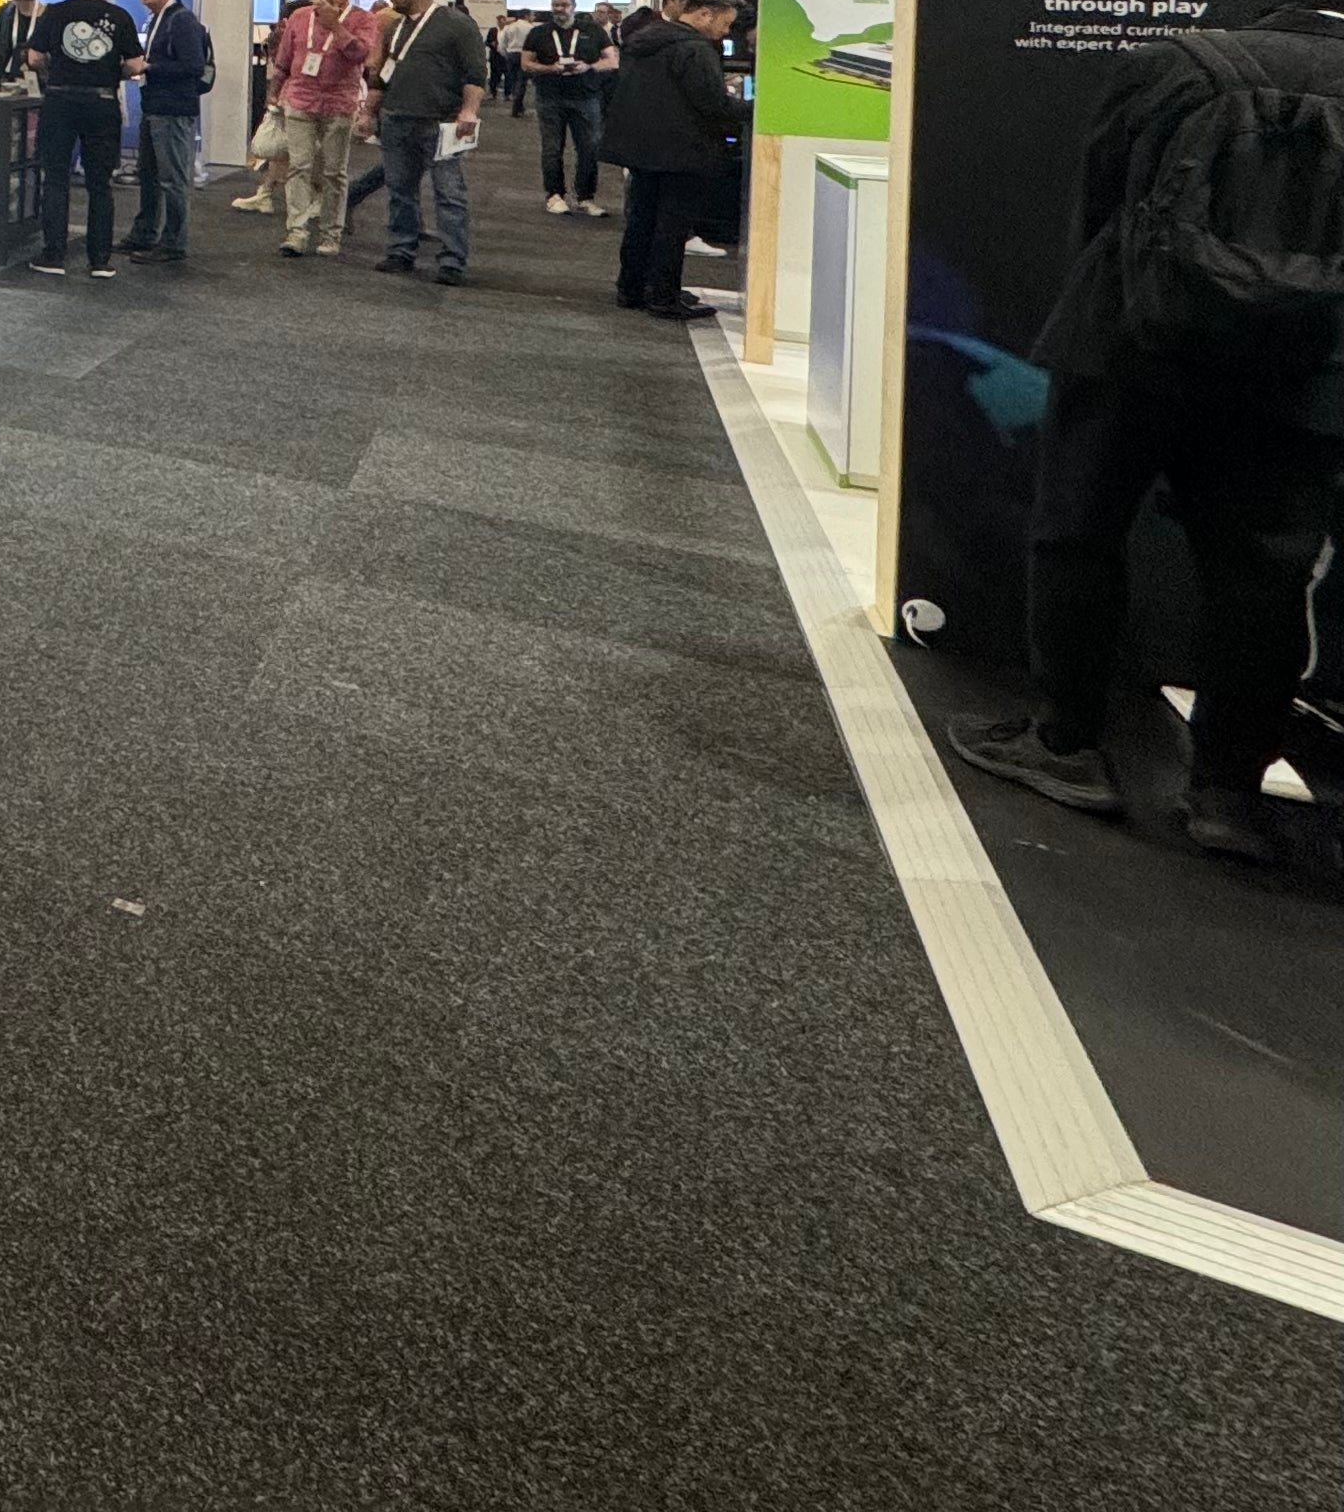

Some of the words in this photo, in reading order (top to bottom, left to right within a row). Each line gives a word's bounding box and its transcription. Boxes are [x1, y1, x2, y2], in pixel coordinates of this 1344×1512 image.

[1029, 21, 1122, 37] Integrated
[1126, 25, 1226, 38] curric
[1014, 37, 1052, 49] with
[1056, 38, 1112, 53] expert
